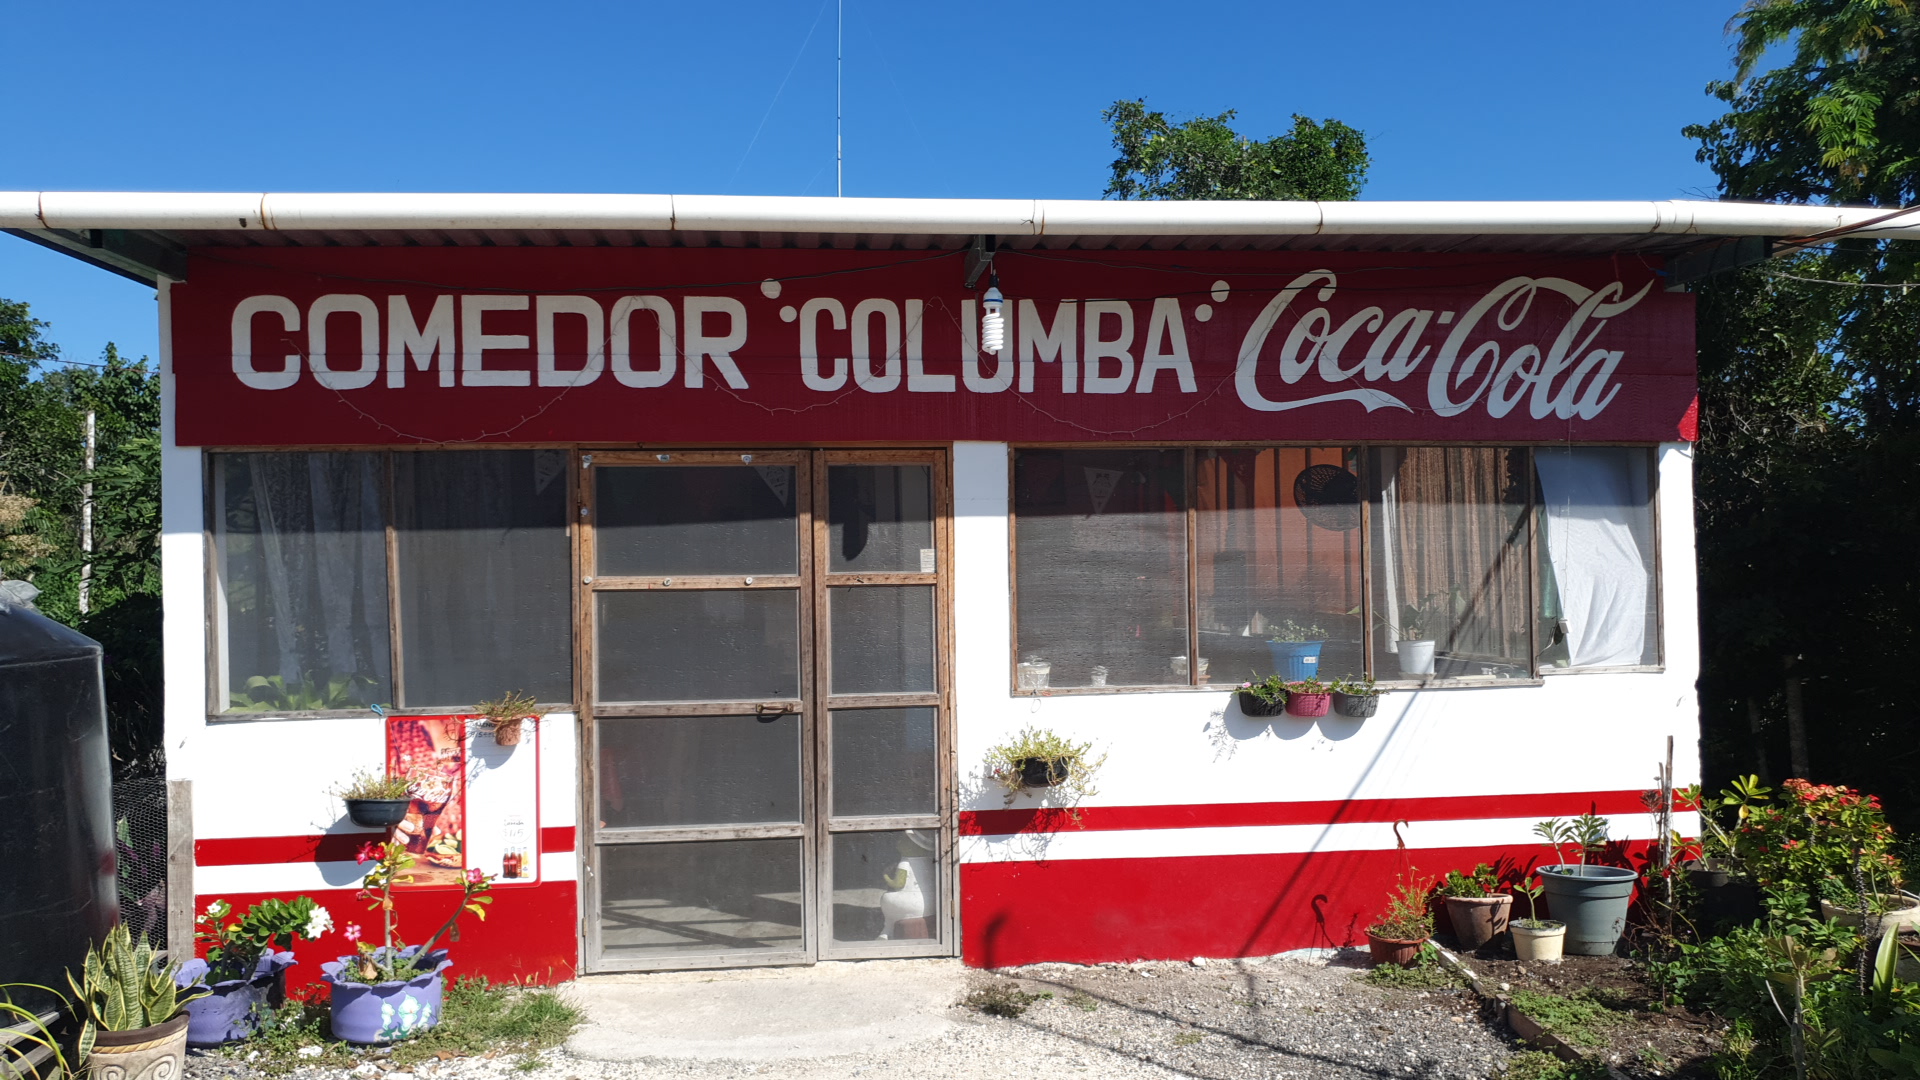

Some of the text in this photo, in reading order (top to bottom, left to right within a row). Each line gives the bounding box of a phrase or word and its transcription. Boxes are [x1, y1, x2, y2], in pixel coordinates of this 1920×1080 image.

[231, 294, 1198, 394] COMEDOR COLUMBA
[1234, 268, 1655, 421] Coca-Cola
